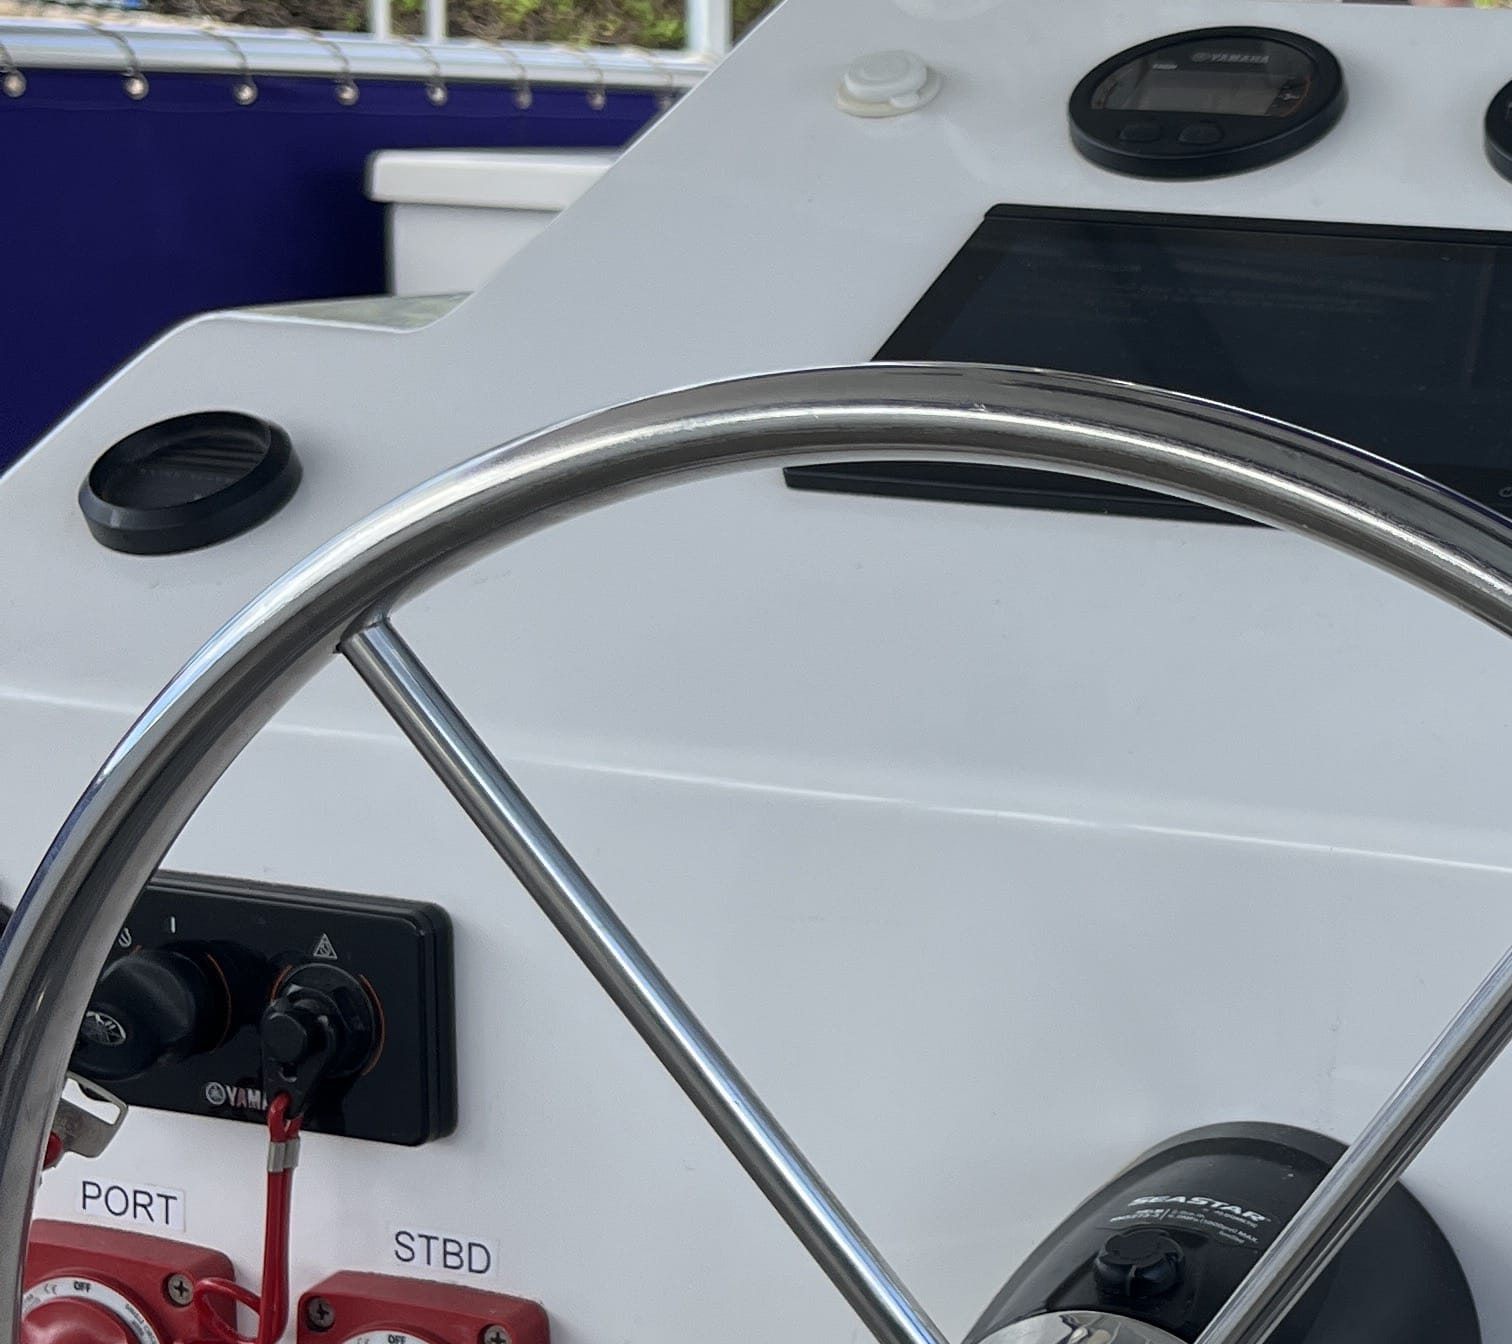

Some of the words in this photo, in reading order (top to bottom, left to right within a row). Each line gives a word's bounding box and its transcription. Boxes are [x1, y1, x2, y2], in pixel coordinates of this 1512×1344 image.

[81, 1180, 177, 1225] PORT
[1128, 1195, 1266, 1222] SEASTAR
[393, 1230, 491, 1274] STBD
[73, 1280, 92, 1294] OFF
